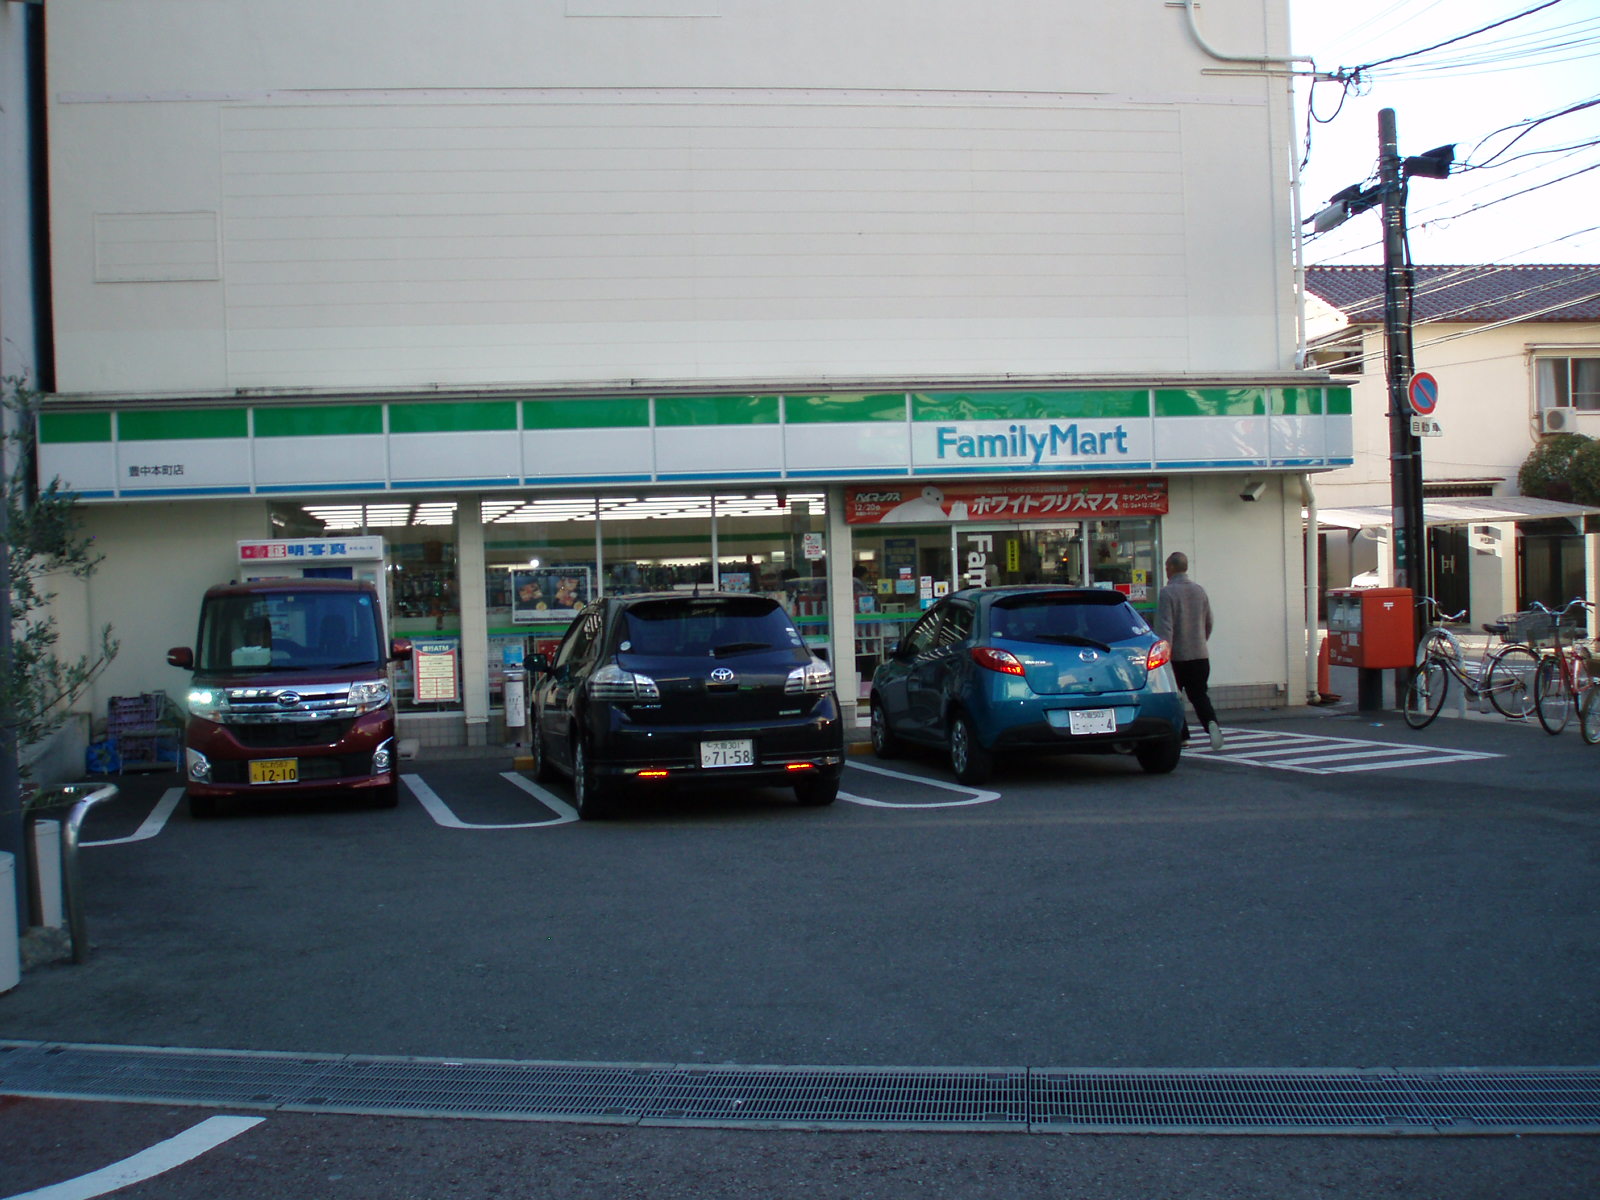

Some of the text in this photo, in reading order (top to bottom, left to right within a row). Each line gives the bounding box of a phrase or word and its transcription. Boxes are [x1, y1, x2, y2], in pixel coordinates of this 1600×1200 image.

[936, 424, 1128, 464] FamilyMart
[971, 493, 1116, 516] ホワイトクリスマス
[712, 750, 751, 765] 71-58
[262, 768, 296, 782] 12-10
